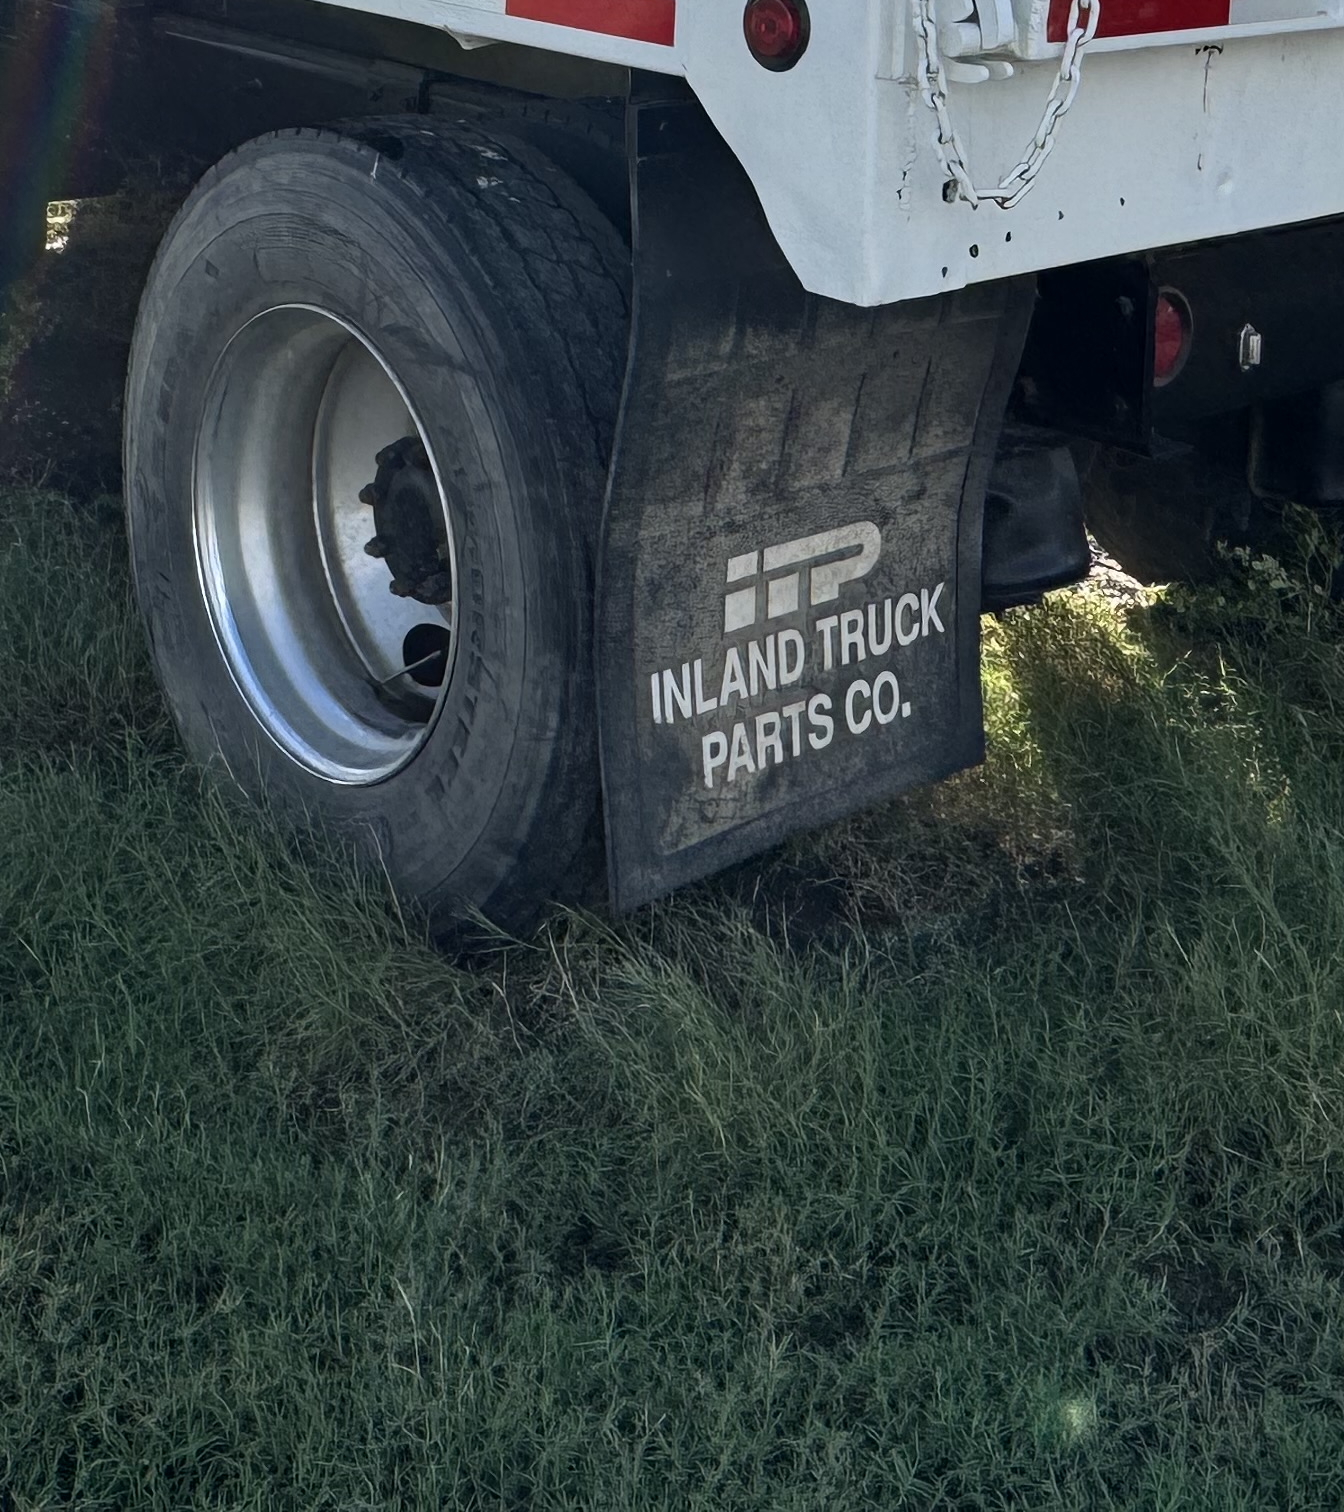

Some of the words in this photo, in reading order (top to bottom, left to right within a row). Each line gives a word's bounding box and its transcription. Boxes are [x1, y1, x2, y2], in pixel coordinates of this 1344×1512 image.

[650, 628, 806, 725] INLAND
[817, 581, 946, 671] TRUCK
[701, 693, 835, 788] PARTS
[844, 670, 912, 735] CO.
